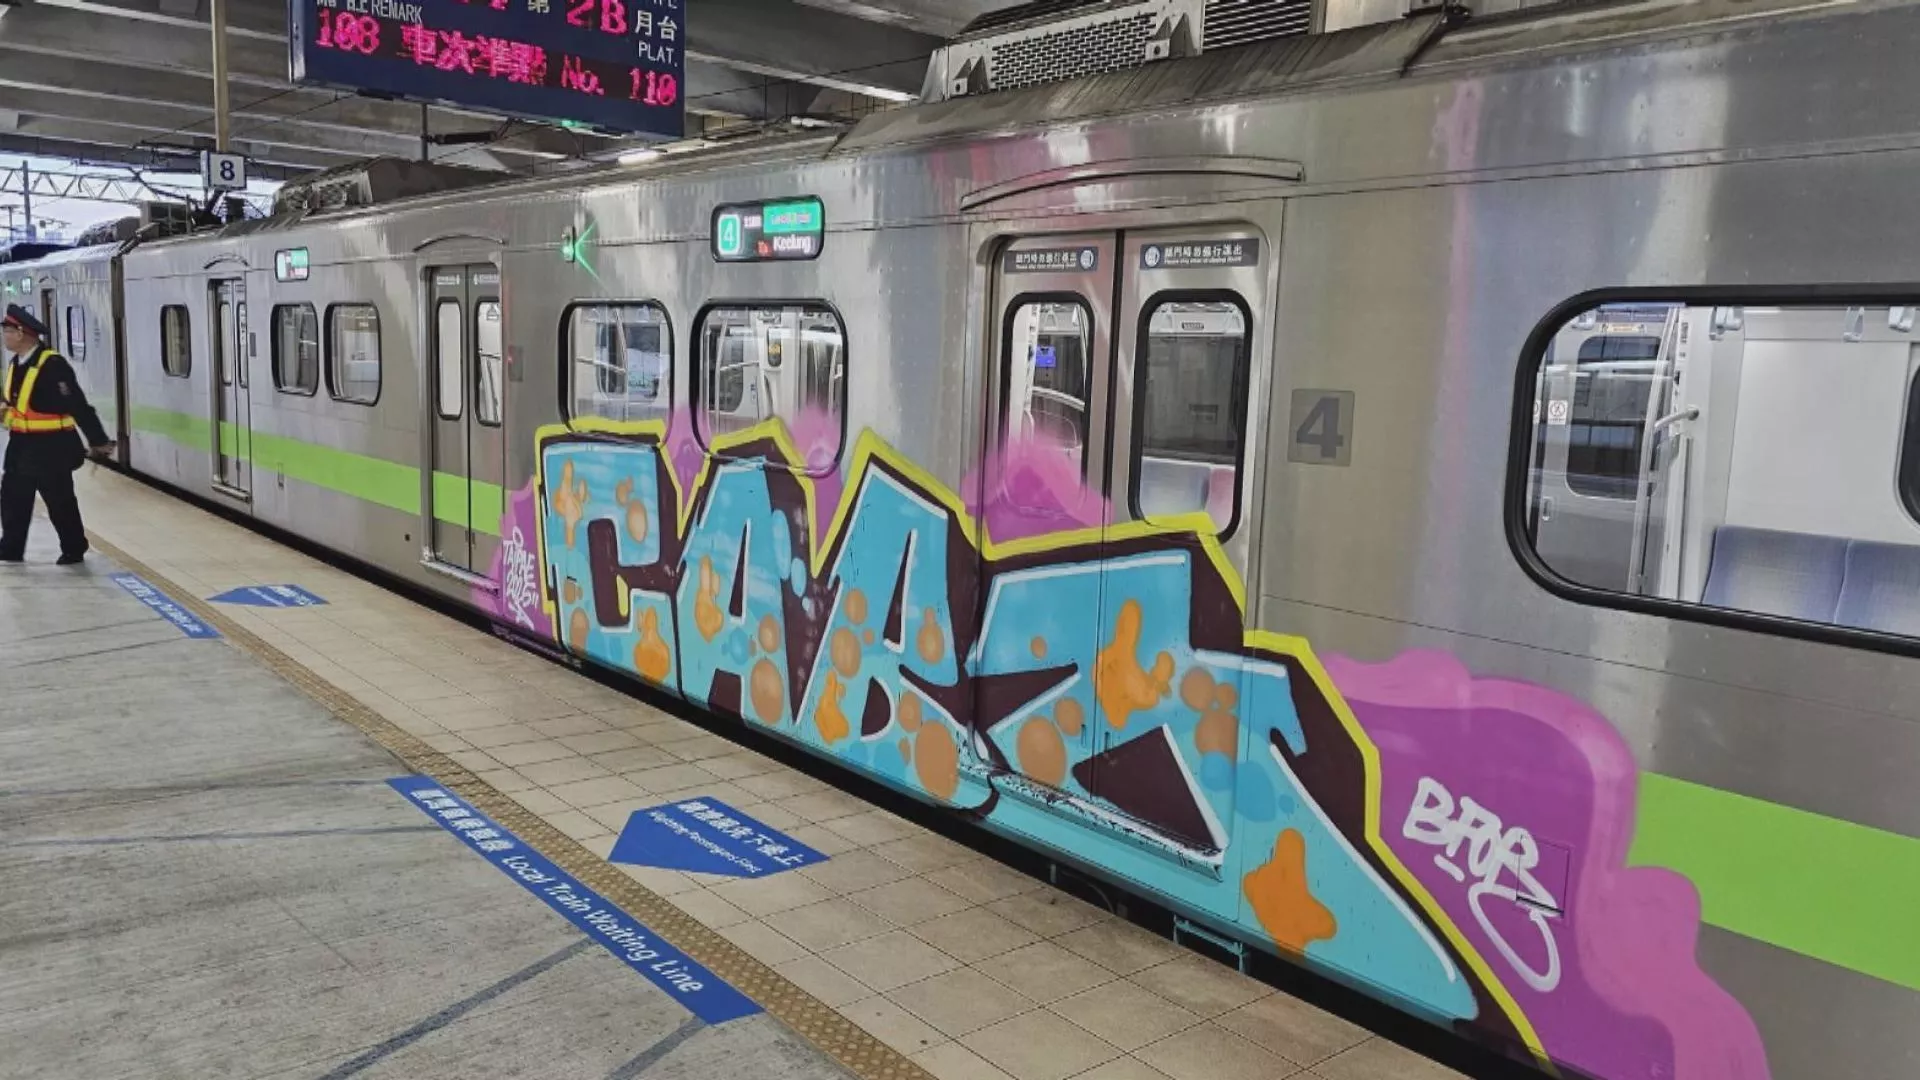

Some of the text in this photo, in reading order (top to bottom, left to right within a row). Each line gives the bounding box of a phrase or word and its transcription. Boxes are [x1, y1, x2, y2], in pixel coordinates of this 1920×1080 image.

[371, 0, 422, 23] REMARK
[566, 0, 626, 34] 2B
[635, 10, 677, 41] 月台
[638, 41, 677, 67] PLAT.
[561, 54, 604, 96] No.
[220, 160, 235, 180] 8
[723, 219, 734, 248] 4
[1297, 396, 1344, 459] 4
[501, 855, 555, 884] Local
[544, 881, 591, 913] Train
[584, 909, 659, 961] Waiting
[651, 960, 704, 993] Line
